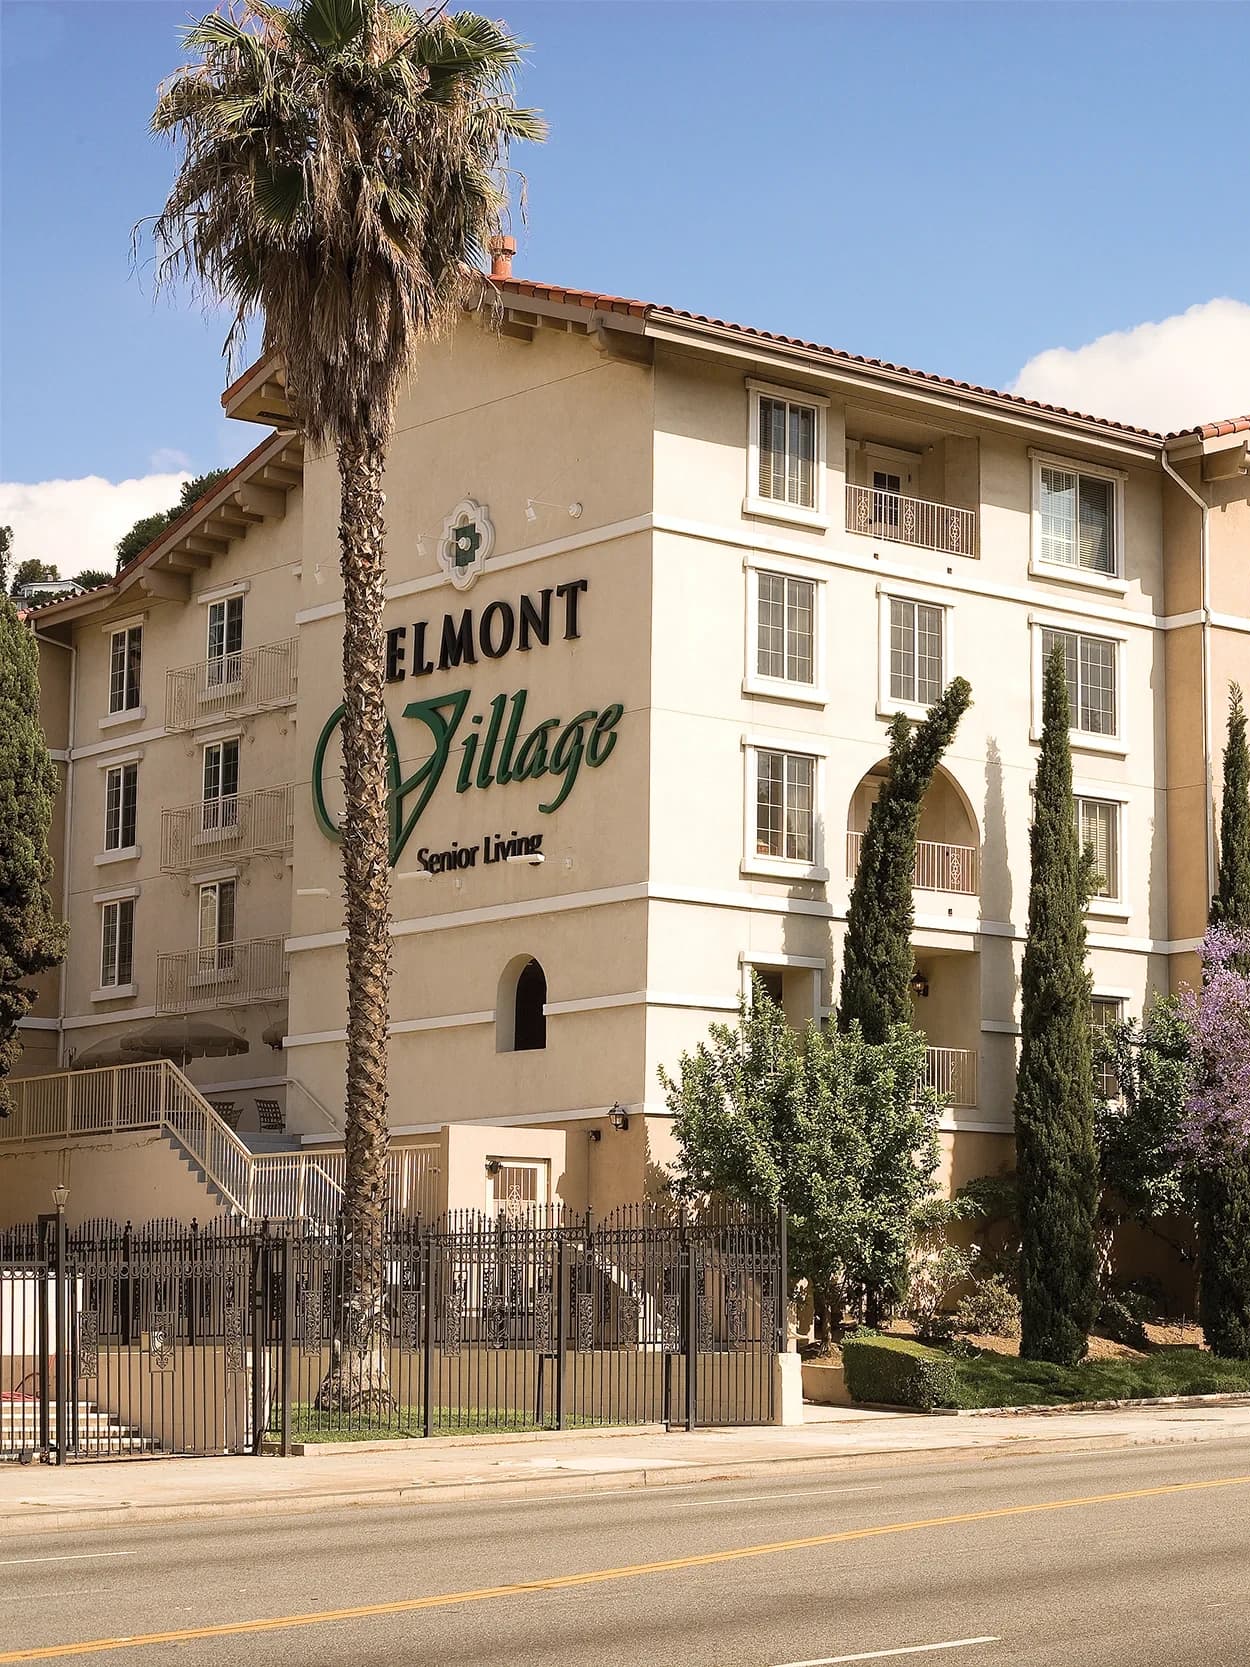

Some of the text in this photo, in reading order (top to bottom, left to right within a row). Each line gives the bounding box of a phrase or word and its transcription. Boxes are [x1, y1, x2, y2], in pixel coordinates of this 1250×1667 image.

[385, 579, 588, 684] ELMONT
[312, 689, 624, 868] Village
[416, 831, 544, 874] Senior Living
